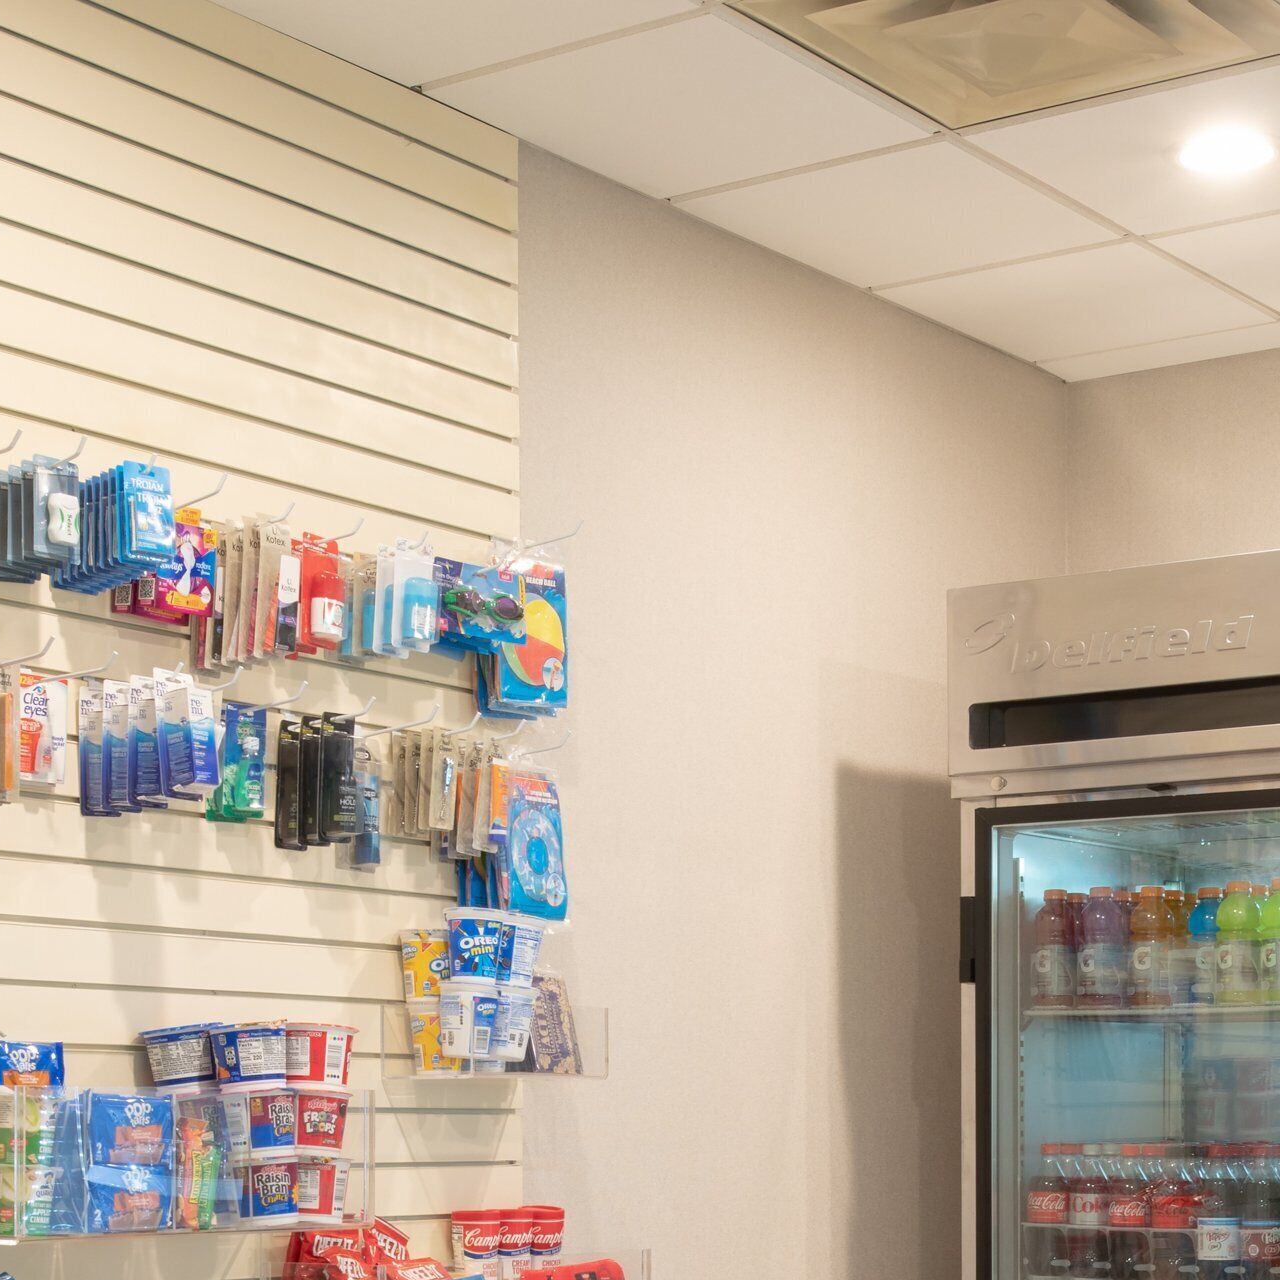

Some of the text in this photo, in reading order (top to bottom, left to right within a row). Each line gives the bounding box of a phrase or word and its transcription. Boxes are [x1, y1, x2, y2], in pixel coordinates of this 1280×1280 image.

[130, 478, 164, 492] TROJAN
[526, 576, 556, 587] BEACH BALL
[23, 692, 50, 706] Clear
[24, 704, 48, 718] eyes
[460, 937, 498, 950] OREO
[470, 946, 494, 956] mini
[96, 1142, 102, 1154] 2
[256, 1172, 290, 1186] Raisin
[261, 1184, 288, 1197] Bran
[94, 1210, 102, 1220] 2
